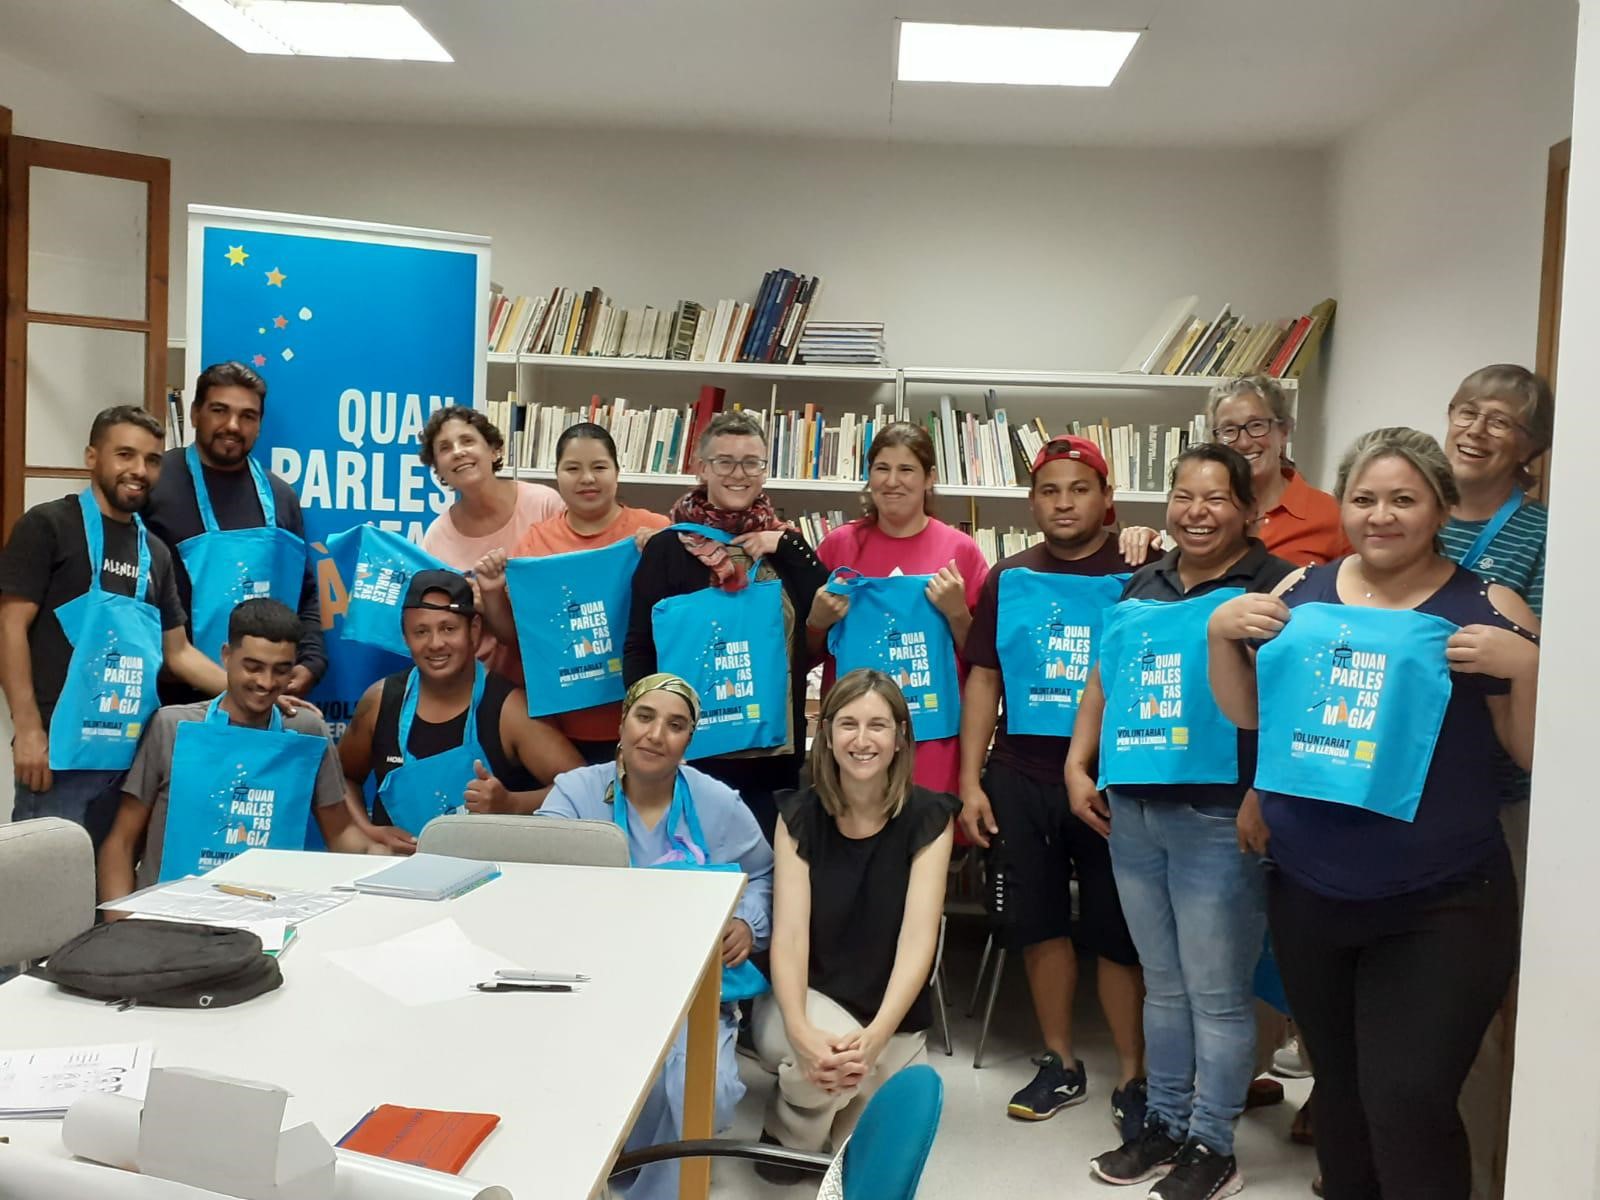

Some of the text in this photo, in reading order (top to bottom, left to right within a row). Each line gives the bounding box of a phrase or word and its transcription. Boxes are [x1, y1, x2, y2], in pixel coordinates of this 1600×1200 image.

[270, 447, 456, 514] PARLES
[360, 583, 374, 599] FAS
[371, 568, 394, 604] PARLES
[579, 600, 604, 616] QUAN
[570, 612, 608, 631] PARLES
[592, 626, 610, 639] FAS
[900, 632, 925, 646] QUAN
[1062, 625, 1090, 639] QUAN
[889, 644, 928, 661] PARLES
[1047, 636, 1090, 653] PARLES
[714, 653, 752, 671] PARLES
[911, 658, 929, 671] FAS
[1070, 652, 1089, 666] FAS
[1155, 653, 1182, 669] QUAN
[1350, 651, 1386, 671] QUAN
[103, 668, 143, 685] PARLES
[1141, 667, 1182, 686] PARLES
[1330, 666, 1384, 691] PARLES
[124, 685, 142, 699] FAS
[1163, 684, 1182, 699] FAS
[1356, 690, 1380, 708] FAS
[1117, 727, 1166, 737] VOLUNTARIAT
[1293, 731, 1351, 749] VOLUNTARIAT
[247, 789, 275, 803] QUAN
[230, 801, 274, 817] PARLES
[253, 817, 272, 831] FAS
